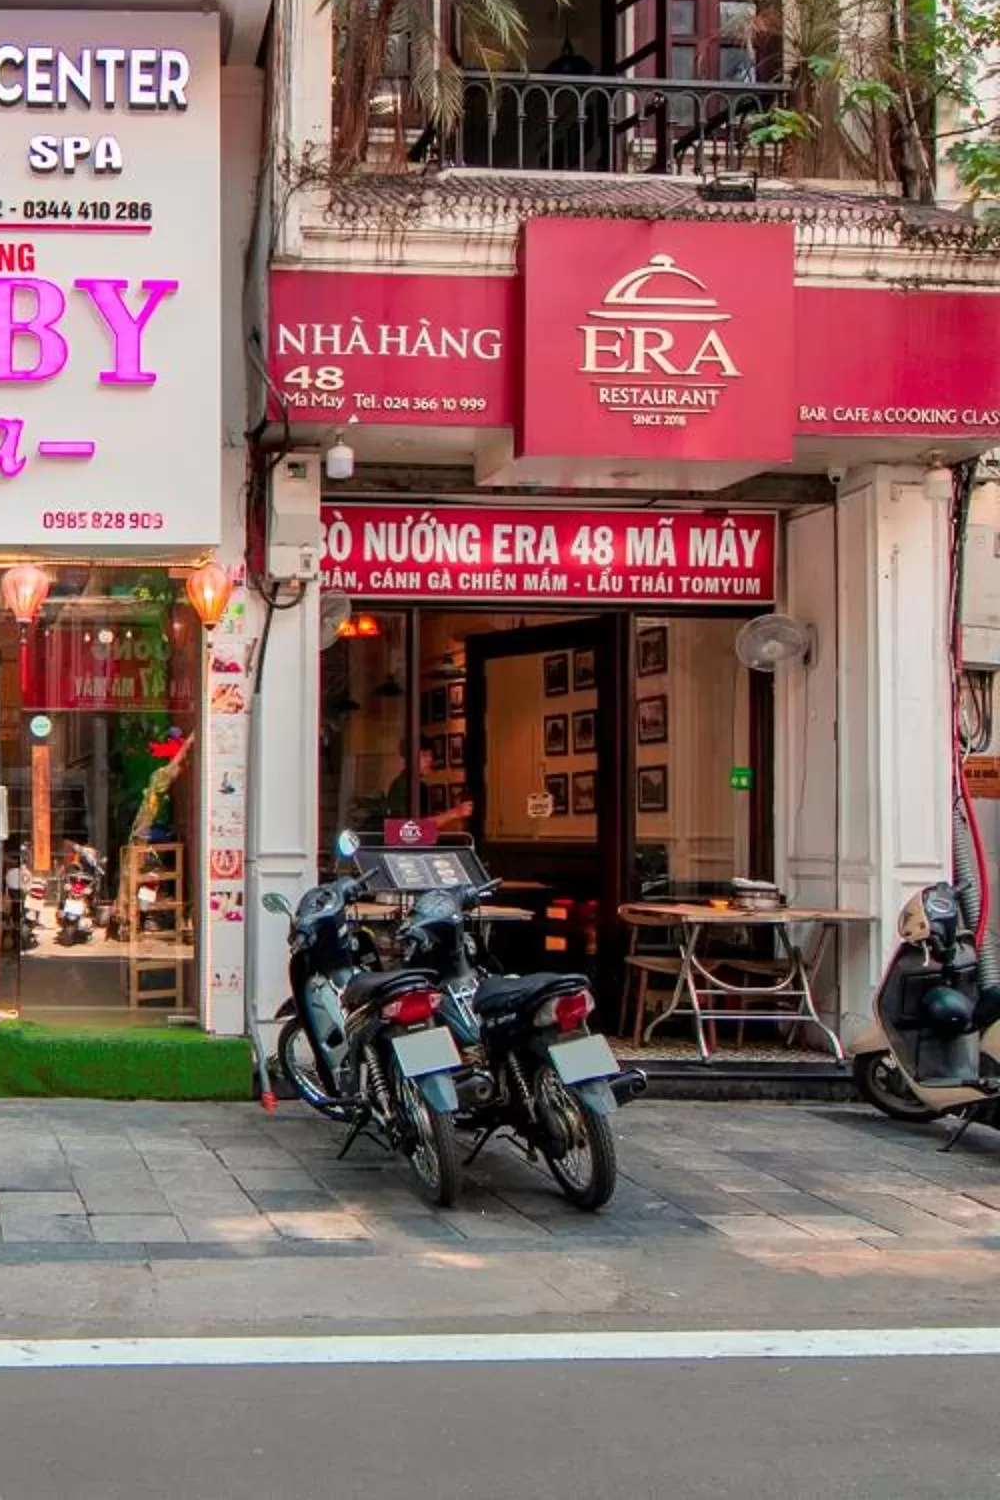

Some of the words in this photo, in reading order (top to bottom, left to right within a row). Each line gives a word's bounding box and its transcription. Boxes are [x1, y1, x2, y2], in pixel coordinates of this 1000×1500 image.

[28, 134, 123, 174] SPA
[23, 201, 72, 220] 0344
[77, 201, 111, 221] 410
[115, 202, 152, 221] 286
[277, 316, 374, 356] NHÀ
[378, 318, 502, 360] HÀNG
[576, 325, 744, 378] ERA
[284, 366, 344, 391] 48
[384, 397, 409, 409] 024
[413, 398, 438, 410] 366
[442, 398, 457, 410] 10
[460, 398, 486, 411] 999
[599, 388, 719, 406] RESTAURANT
[799, 405, 827, 421] BAR
[833, 407, 869, 422] CAFE
[884, 407, 957, 423] COOKING
[363, 511, 481, 564] NƯỚNG
[492, 524, 560, 565] ERA
[571, 525, 614, 566] 48
[625, 517, 677, 567] MÃ
[688, 517, 761, 568] MÂY
[369, 567, 421, 590] CÁNH
[427, 568, 452, 590] GÀ
[458, 569, 517, 591] CHIÊN
[629, 572, 673, 593] THÁI
[680, 576, 761, 595] TOMYUM
